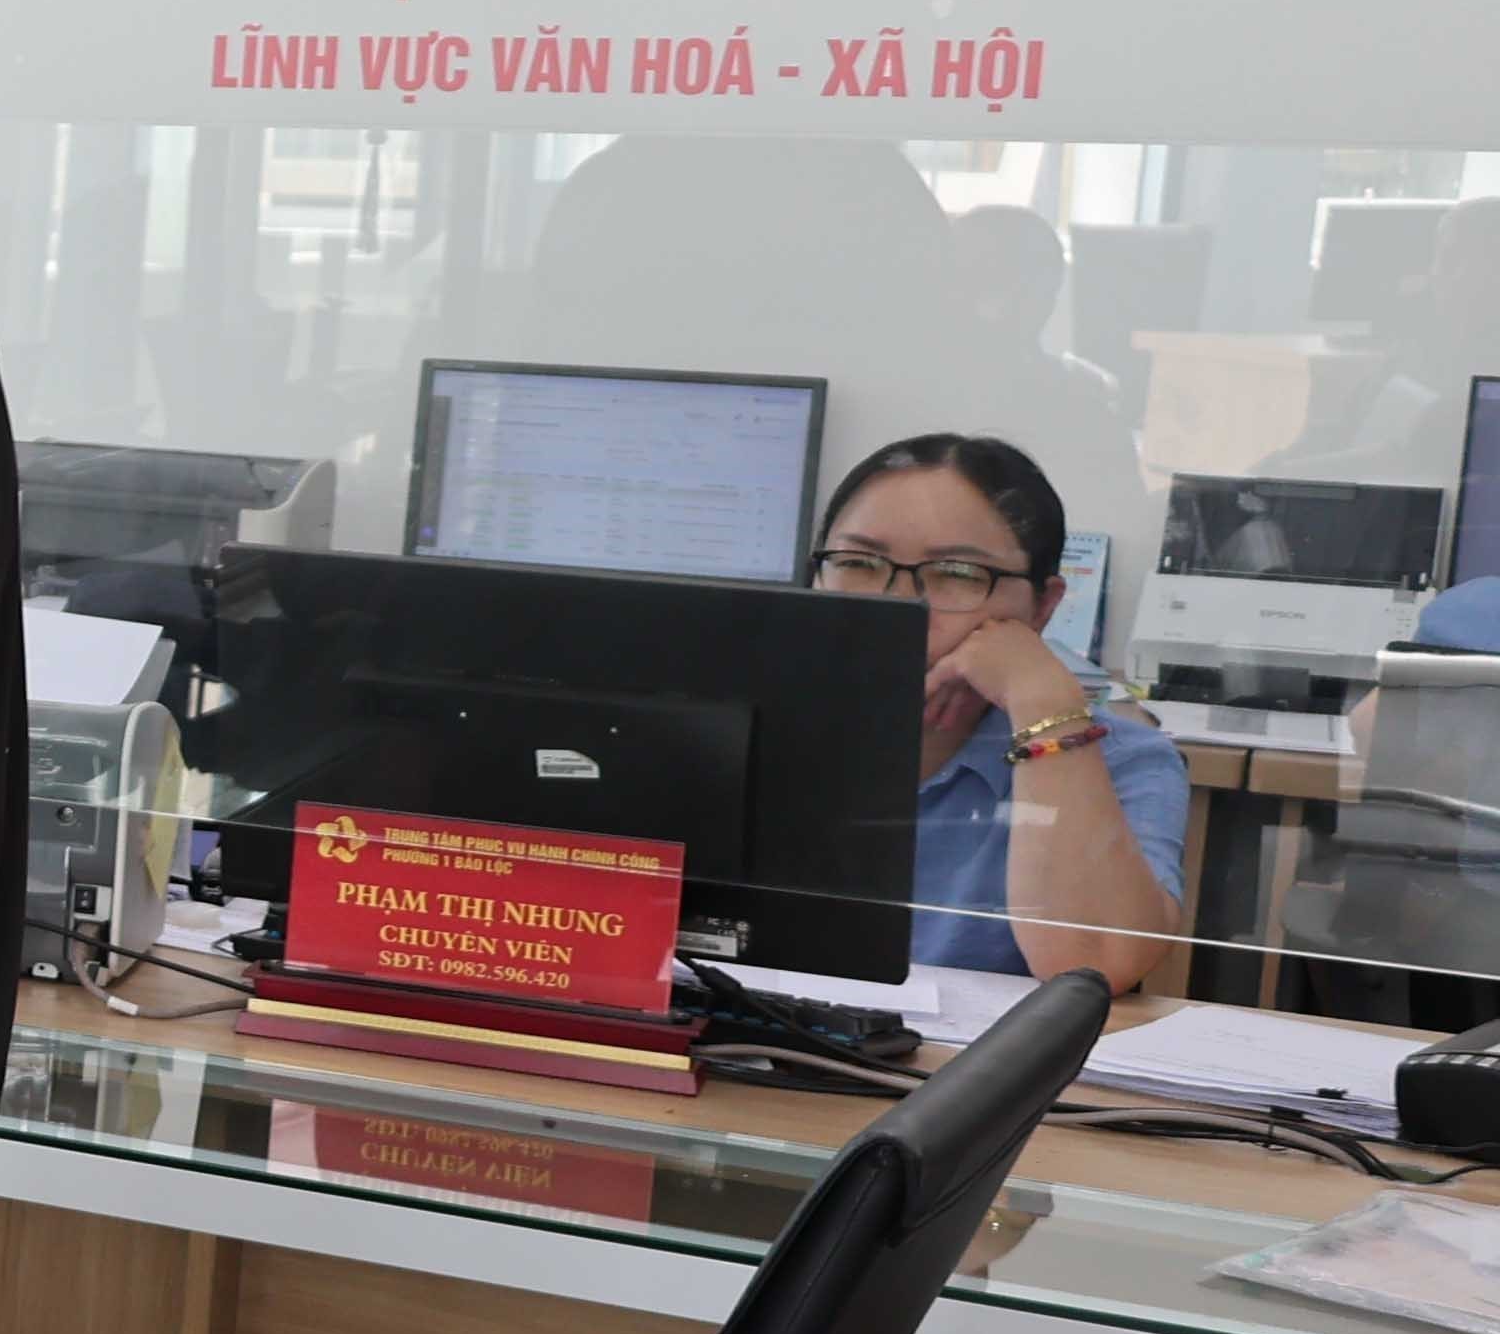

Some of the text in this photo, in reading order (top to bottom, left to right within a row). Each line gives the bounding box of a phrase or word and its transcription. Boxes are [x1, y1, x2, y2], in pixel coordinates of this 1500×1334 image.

[210, 23, 1045, 114] LĨNH VỰC VĂN HOÁ - XÃ HỘI
[1258, 608, 1306, 621] EPSON
[384, 827, 429, 846] TRUNG
[431, 831, 462, 849] TÂM
[619, 850, 660, 869] CÔNG
[443, 852, 450, 866] 1
[485, 856, 514, 877] LỘC
[337, 881, 626, 937] PHẠM THỊ NHUNG
[379, 925, 573, 965] CHUYÊN VIÊN
[378, 950, 570, 989] SĐT: 0982.596.420
